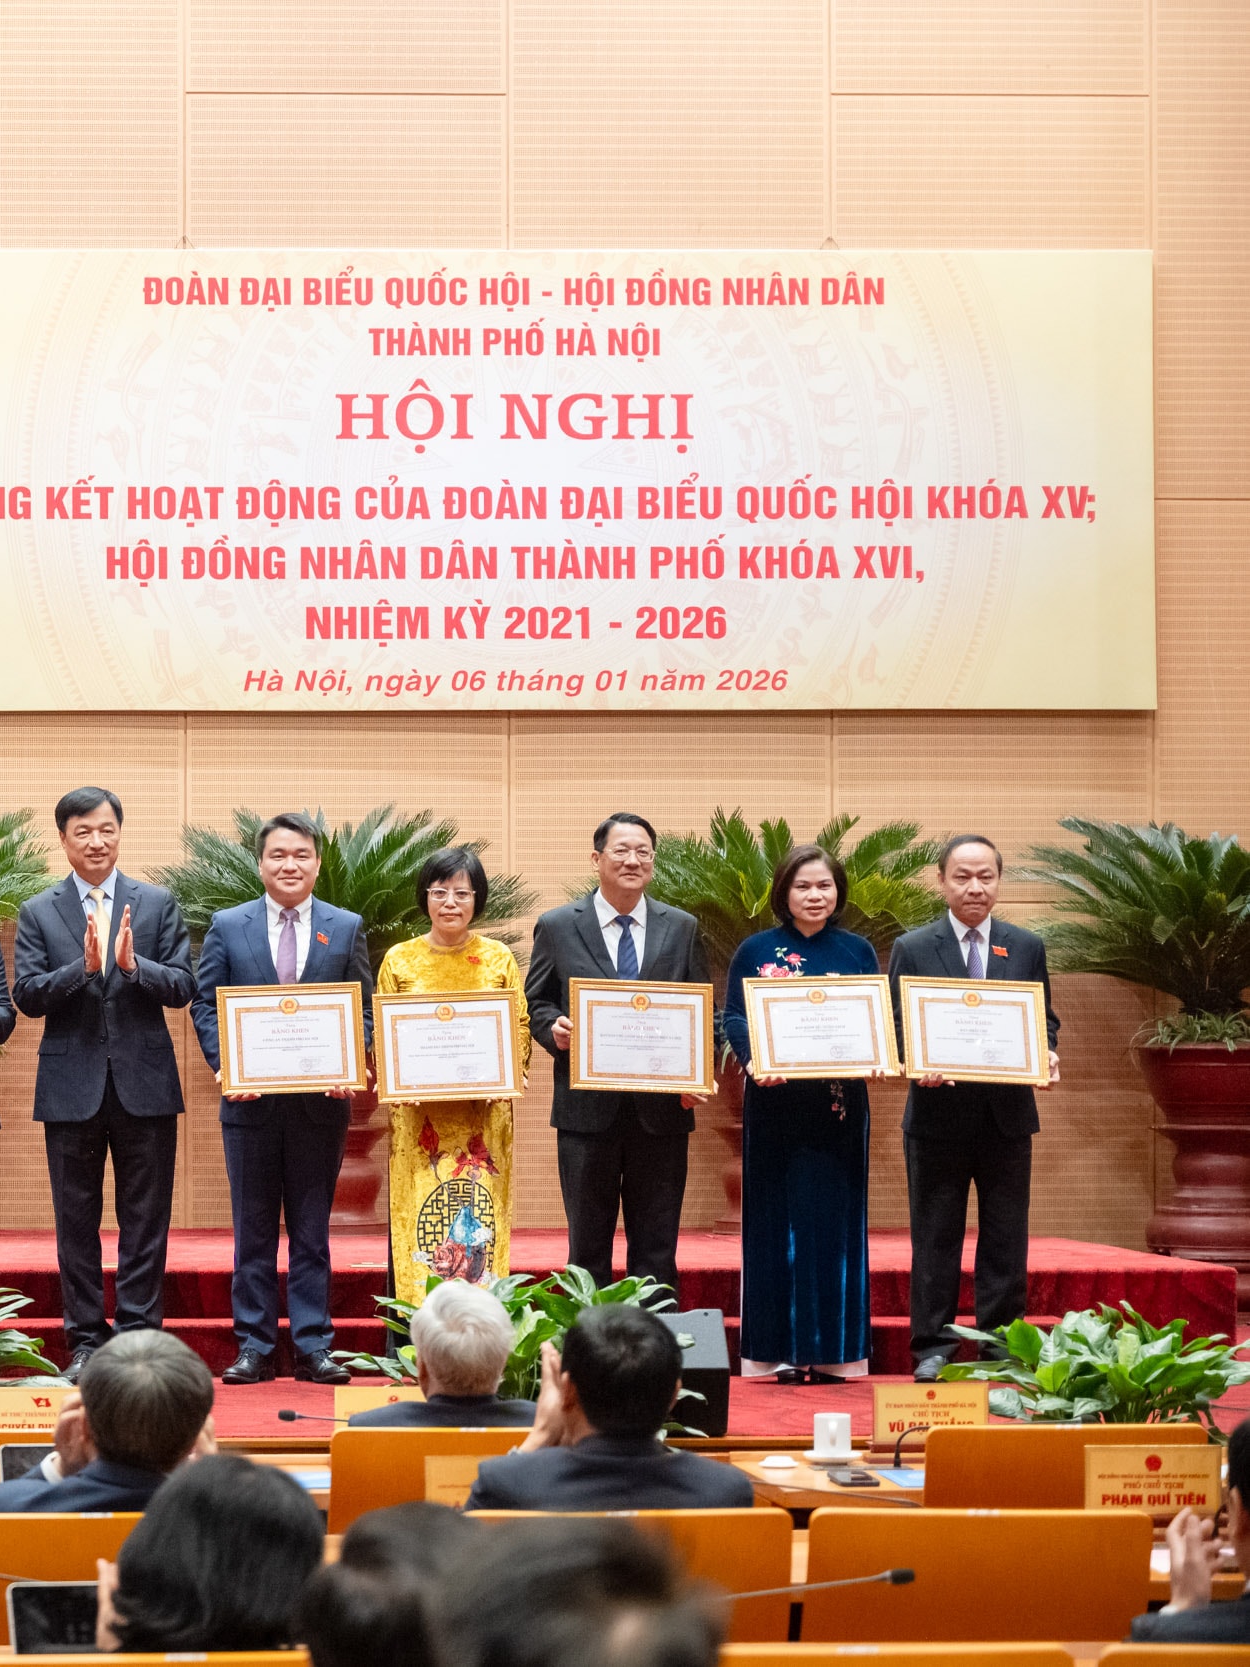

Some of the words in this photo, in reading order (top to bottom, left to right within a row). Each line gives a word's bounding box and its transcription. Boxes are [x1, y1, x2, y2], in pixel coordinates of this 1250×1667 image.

[142, 270, 229, 306] ĐOÀN
[239, 277, 292, 313] ĐẠI
[303, 265, 374, 307] BIỂU
[385, 267, 468, 310] QUỐC
[479, 271, 530, 313] HỘI
[563, 271, 615, 313] HỘI
[624, 268, 712, 307] ĐỒNG
[722, 271, 810, 306] NHÂN
[820, 271, 885, 306] DÂN
[368, 321, 471, 357] THÀNH
[482, 317, 545, 357] PHỐ
[555, 321, 597, 357] HÀ
[607, 321, 661, 363] NỘI
[335, 377, 474, 454] HỘI
[499, 392, 694, 455] NGHỊ
[45, 474, 115, 520] KẾT
[127, 485, 225, 528] HOẠT
[235, 479, 341, 528] ĐỘNG
[354, 474, 431, 521] CỦA
[442, 479, 548, 521] ĐOÀN
[559, 486, 623, 528] ĐẠI
[637, 471, 723, 521] BIỂU
[736, 473, 838, 524] QUỐC
[851, 478, 913, 528] HỘI
[927, 478, 1029, 520] KHÓA
[1041, 485, 1096, 523] XV;
[105, 538, 168, 588] HỘI
[180, 534, 287, 581] ĐỒNG
[300, 538, 407, 580] NHÂN
[420, 538, 498, 580] DÂN
[510, 538, 636, 580] THÀNH
[649, 533, 725, 580] PHỐ
[738, 538, 841, 580] KHÓA
[853, 545, 925, 584] XVI,
[305, 598, 430, 648] NHIỆM
[443, 598, 491, 640] KỲ
[503, 605, 591, 640] 2021
[608, 621, 623, 629] -
[635, 605, 728, 640] 2026
[243, 668, 284, 692] Hà
[294, 668, 353, 697] Nội,
[364, 668, 441, 698] ngày
[451, 669, 487, 692] 06
[496, 668, 585, 698] tháng
[595, 669, 628, 692] 01
[639, 669, 706, 692] năm
[715, 668, 789, 692] 2026
